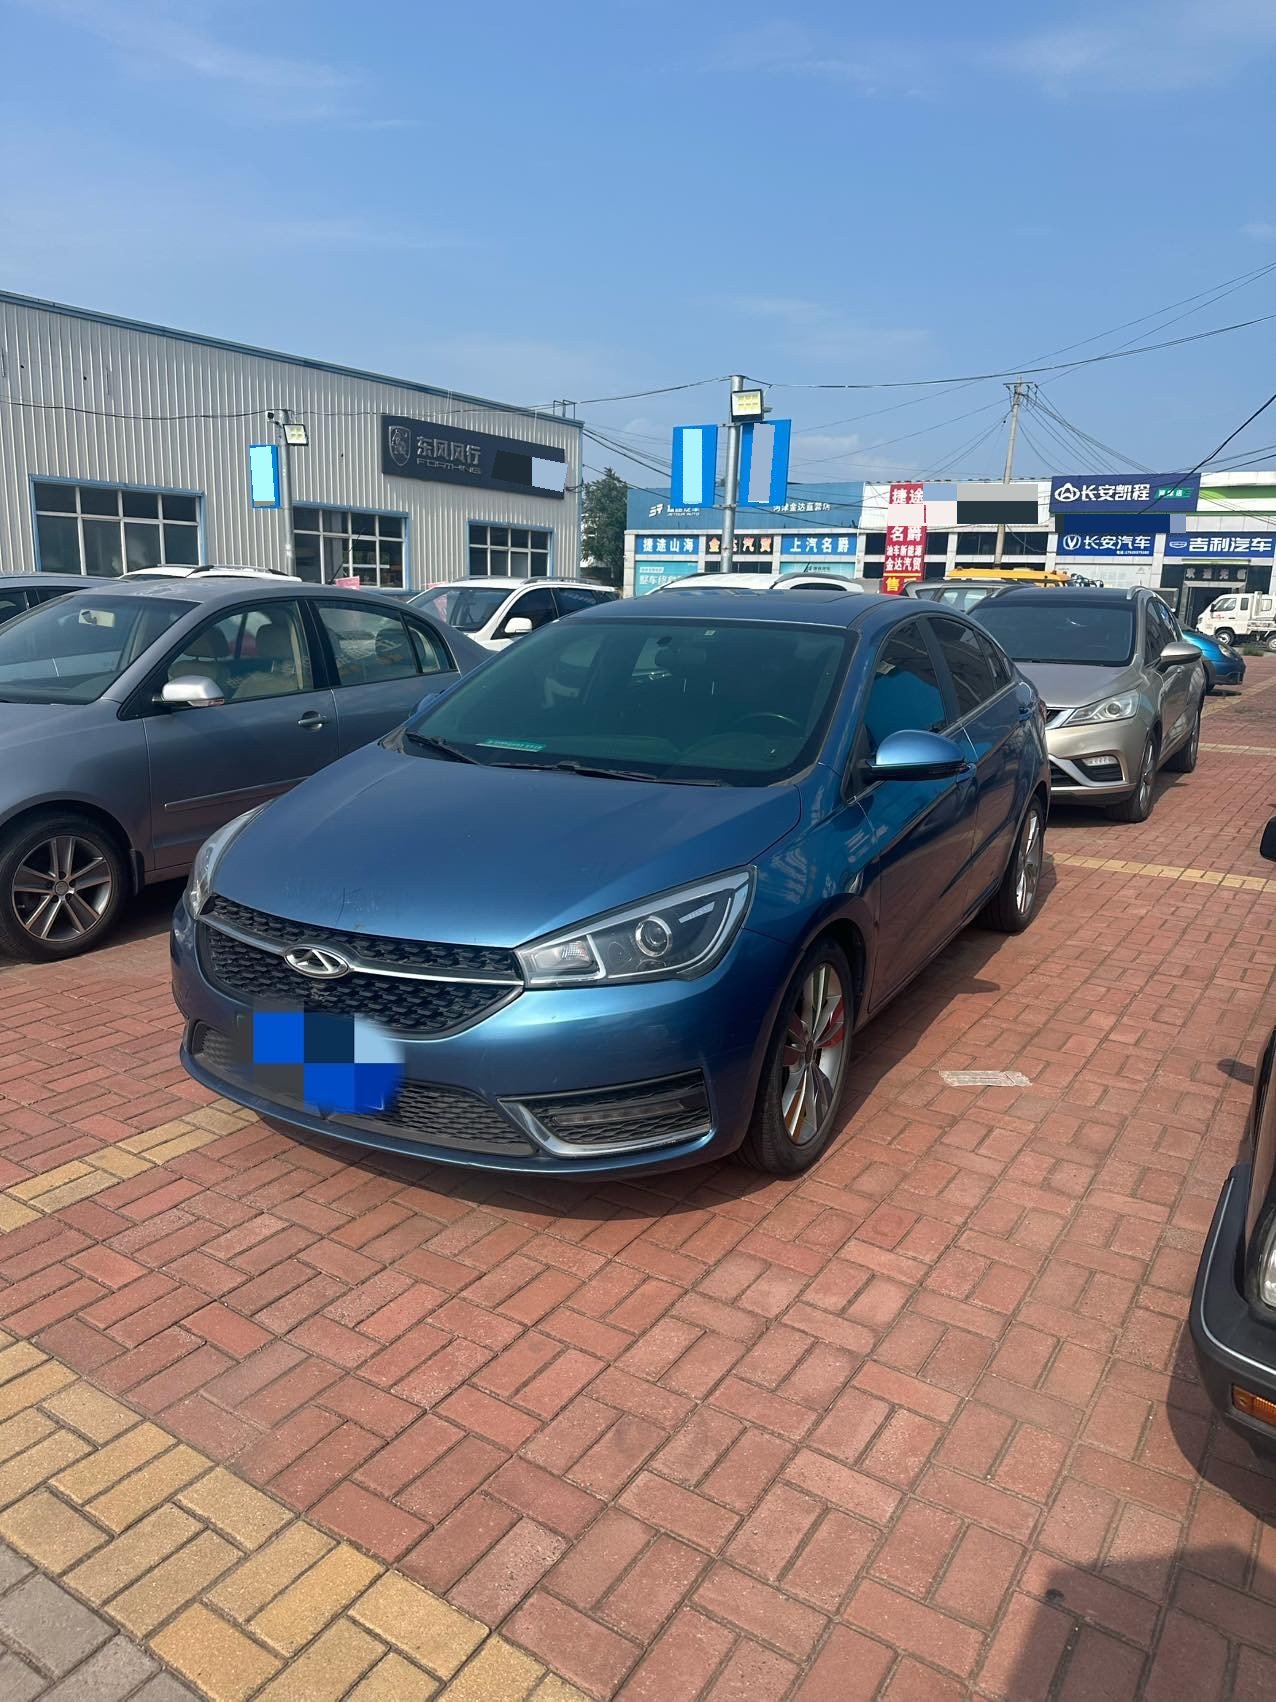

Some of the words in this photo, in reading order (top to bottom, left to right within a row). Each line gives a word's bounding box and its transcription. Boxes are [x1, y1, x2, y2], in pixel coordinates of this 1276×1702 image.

[416, 436, 481, 465] 东风风行
[416, 457, 482, 474] FORTHING
[891, 487, 924, 504] 捷途
[1081, 483, 1151, 501] 长安凯程
[890, 526, 922, 542] 名爵
[642, 537, 694, 553] 捷途山海
[790, 537, 850, 553] 上汽名爵
[886, 545, 922, 556] 油车新能源
[1083, 535, 1151, 550] 长安汽车
[1188, 537, 1272, 552] 吉利汽车
[885, 557, 922, 571] 金达汽贸
[1185, 567, 1247, 580] 欢迎光临
